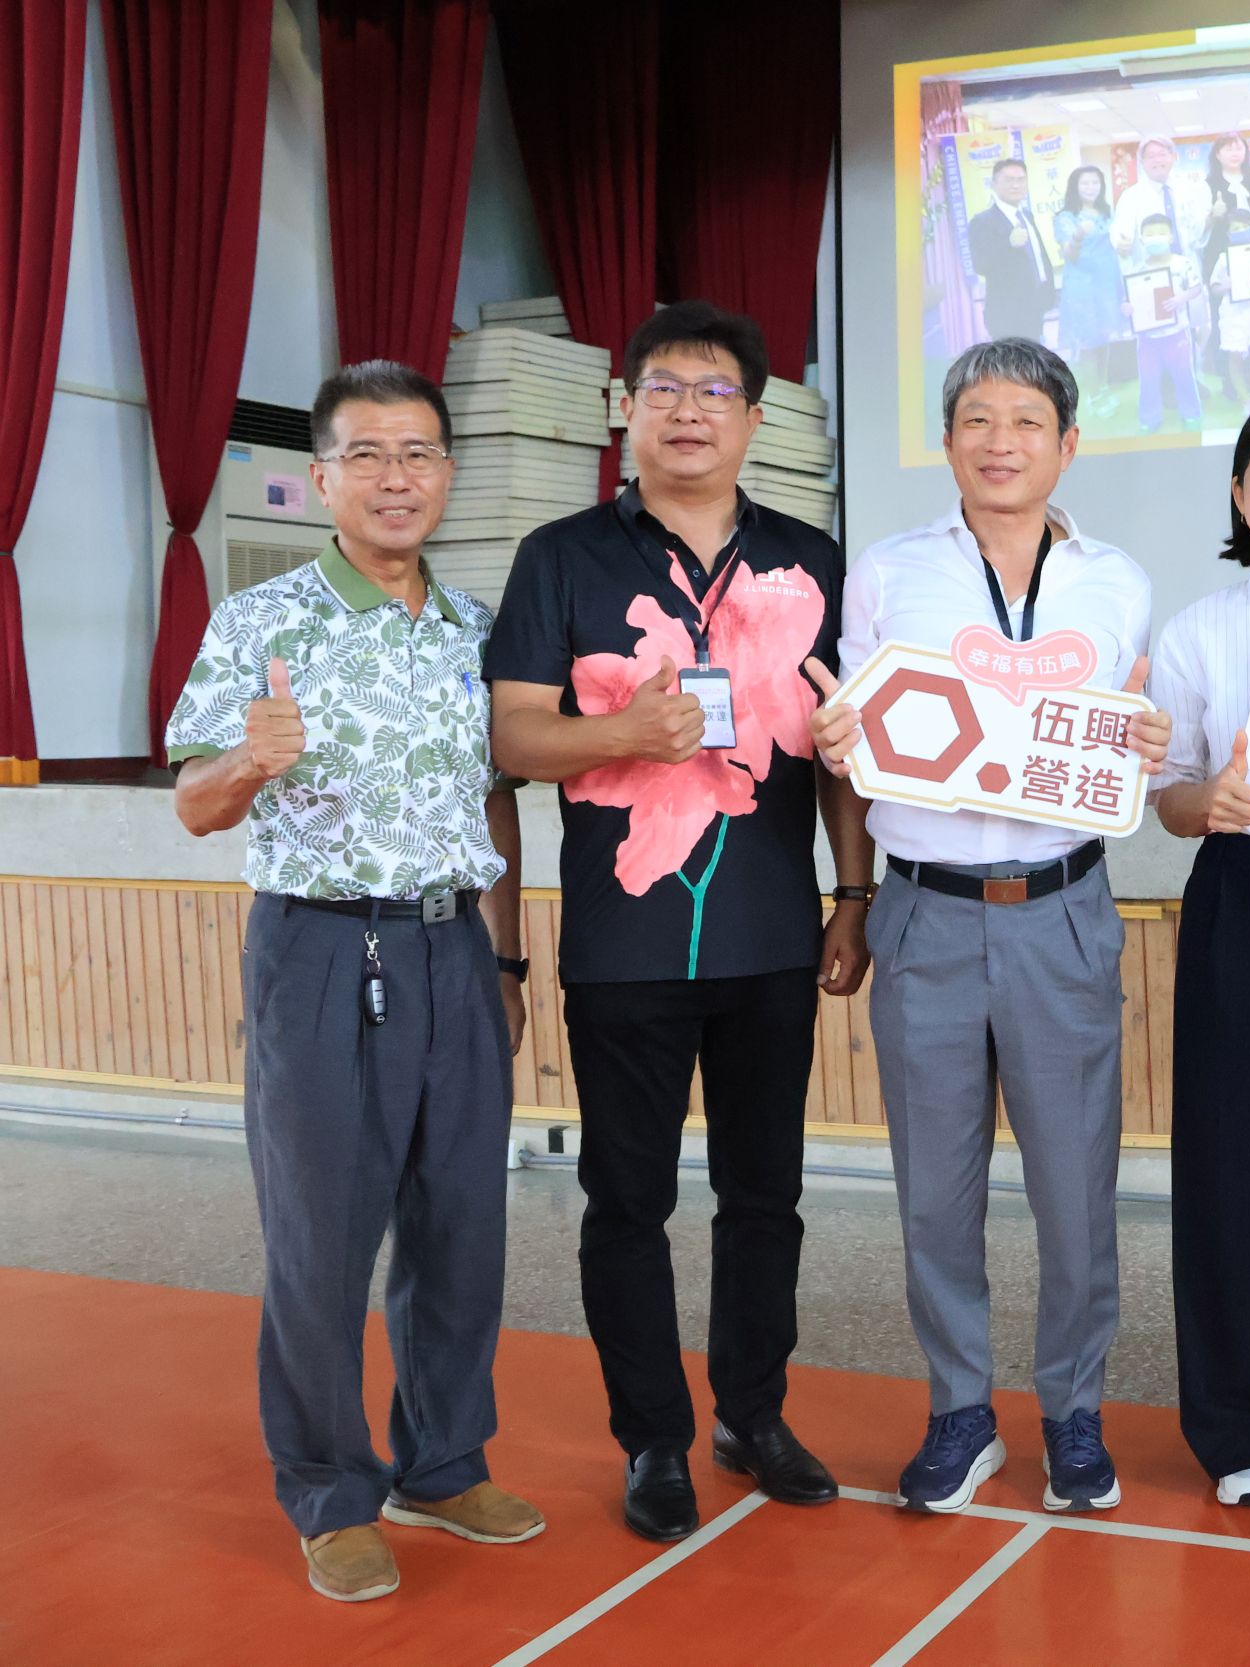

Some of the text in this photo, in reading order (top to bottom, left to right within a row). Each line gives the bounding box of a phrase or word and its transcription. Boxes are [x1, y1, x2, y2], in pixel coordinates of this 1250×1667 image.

[743, 585, 809, 599] J.LINDEBERG
[967, 648, 1082, 676] 幸福有伍興
[1031, 697, 1132, 759] 伍興
[1021, 754, 1124, 817] 營造
